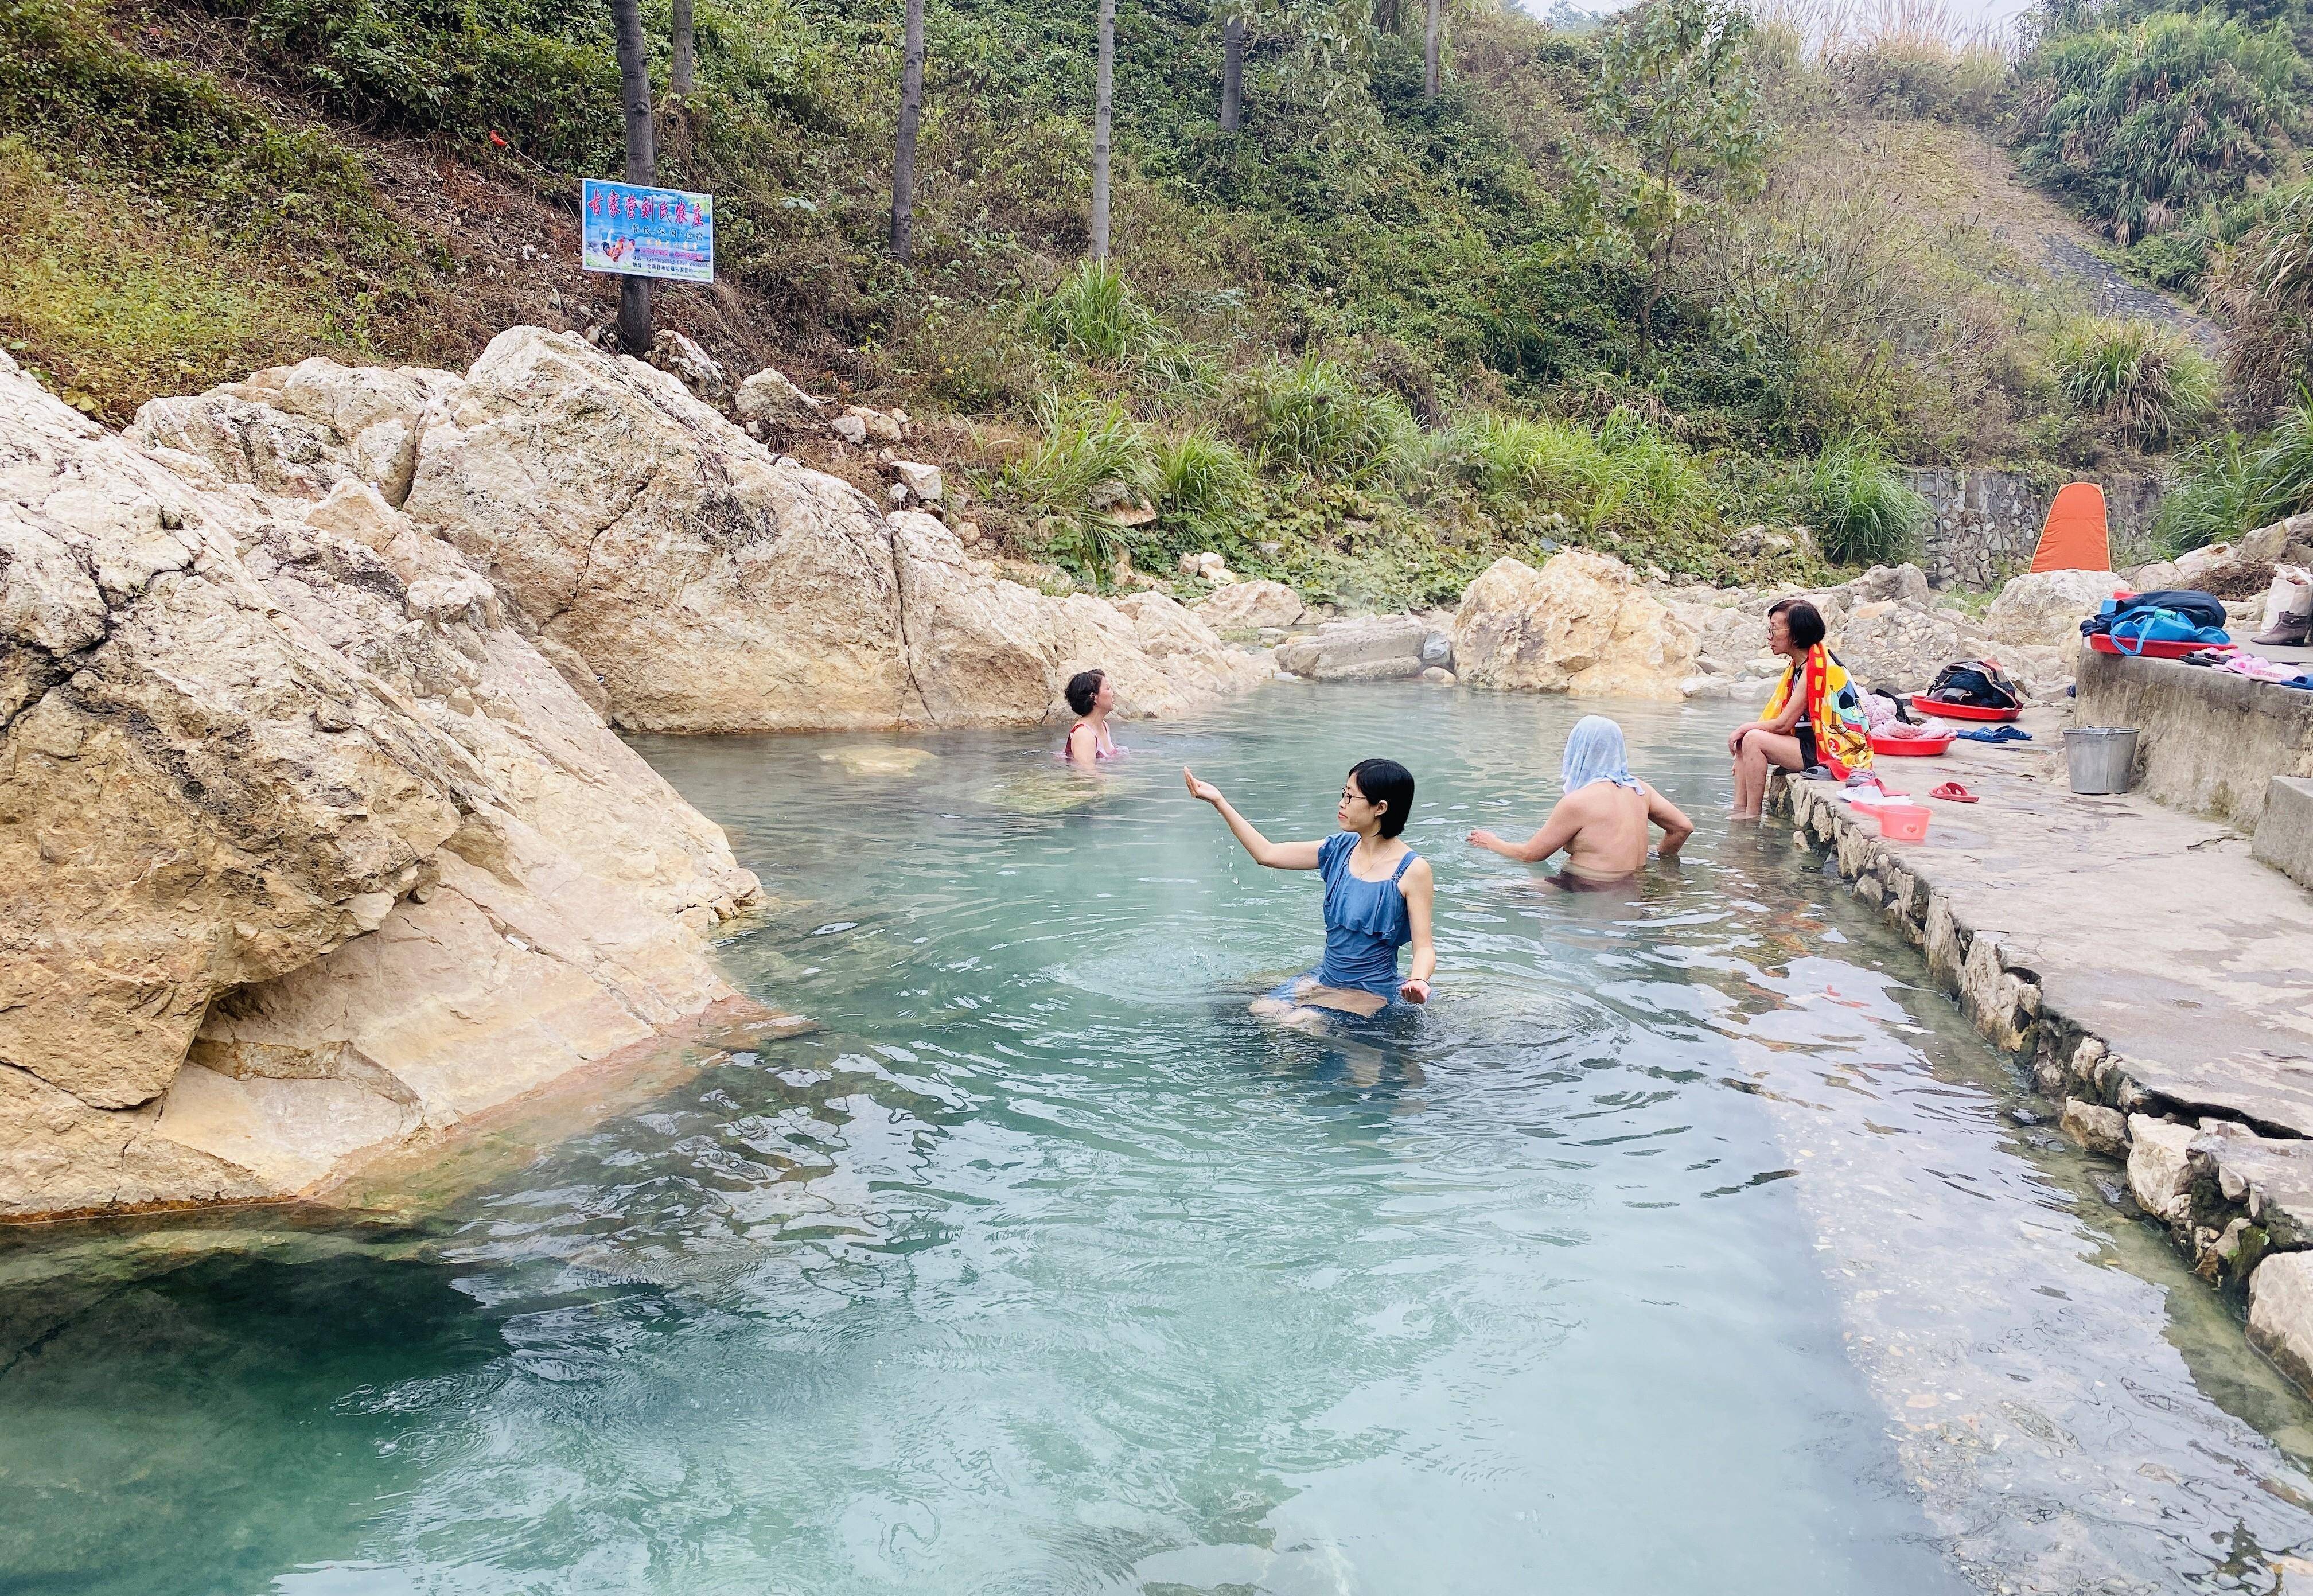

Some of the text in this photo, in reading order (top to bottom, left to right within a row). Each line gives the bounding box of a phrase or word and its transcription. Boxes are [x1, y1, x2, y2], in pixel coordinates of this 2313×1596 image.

[588, 188, 704, 227] 古家营刘氏农庄
